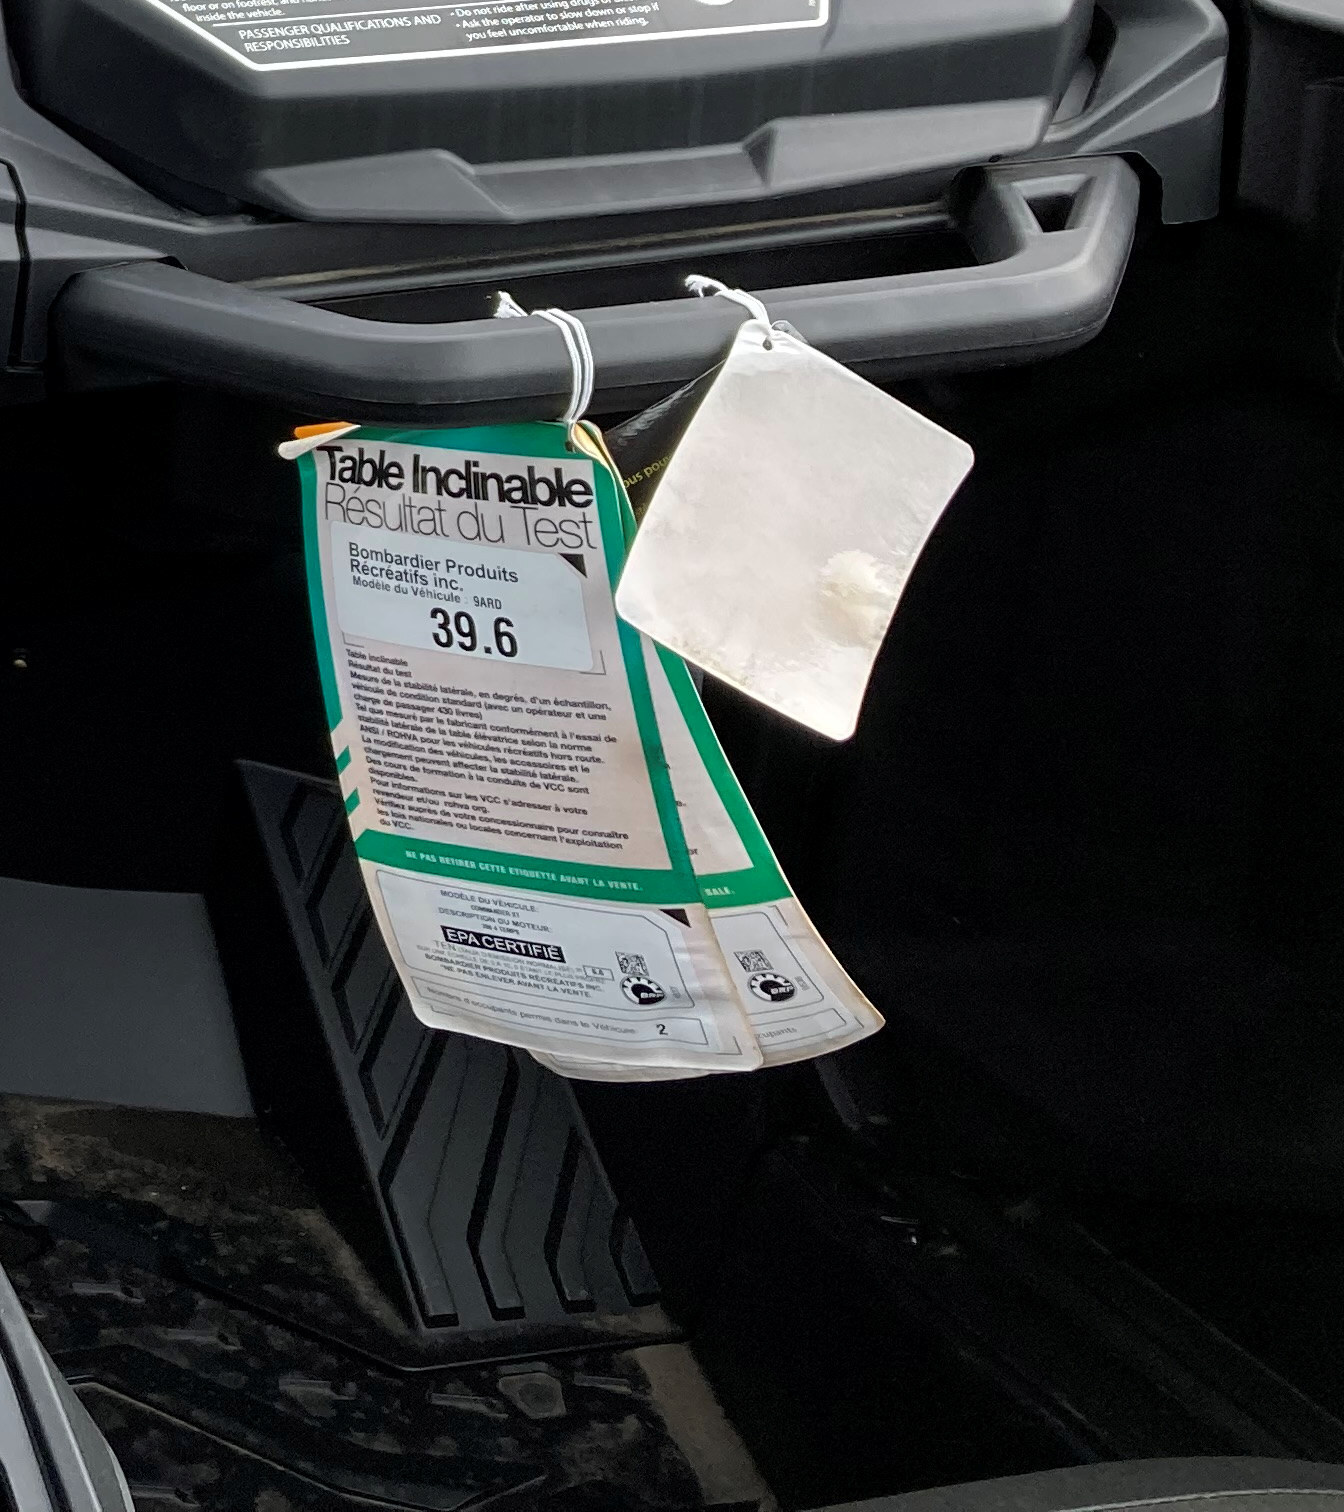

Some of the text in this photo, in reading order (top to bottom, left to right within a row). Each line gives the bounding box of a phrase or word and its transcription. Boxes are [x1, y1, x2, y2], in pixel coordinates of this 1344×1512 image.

[454, 7, 472, 17] Do
[472, 6, 492, 16] not
[492, 4, 513, 14] ride
[514, 2, 538, 12] after
[539, 0, 569, 12] using
[238, 14, 442, 40] PASSENGER QUALIFICATIONS AND
[244, 34, 352, 52] RESPONSIBILITIES
[316, 446, 594, 508] Table Inclinable
[324, 482, 597, 549] Résultat du Test
[349, 542, 518, 583] Bombardier Produits
[350, 559, 464, 591] Récréatifs inc.
[352, 575, 502, 610] Modèle du Véhicule 9ARD
[430, 607, 518, 658] 39.6
[405, 850, 417, 859] NE
[420, 852, 436, 863] PAS
[479, 861, 506, 874] CETTE
[445, 929, 478, 946] EPA
[482, 936, 562, 961] CERTIFIÉ
[656, 1023, 668, 1036] 2
